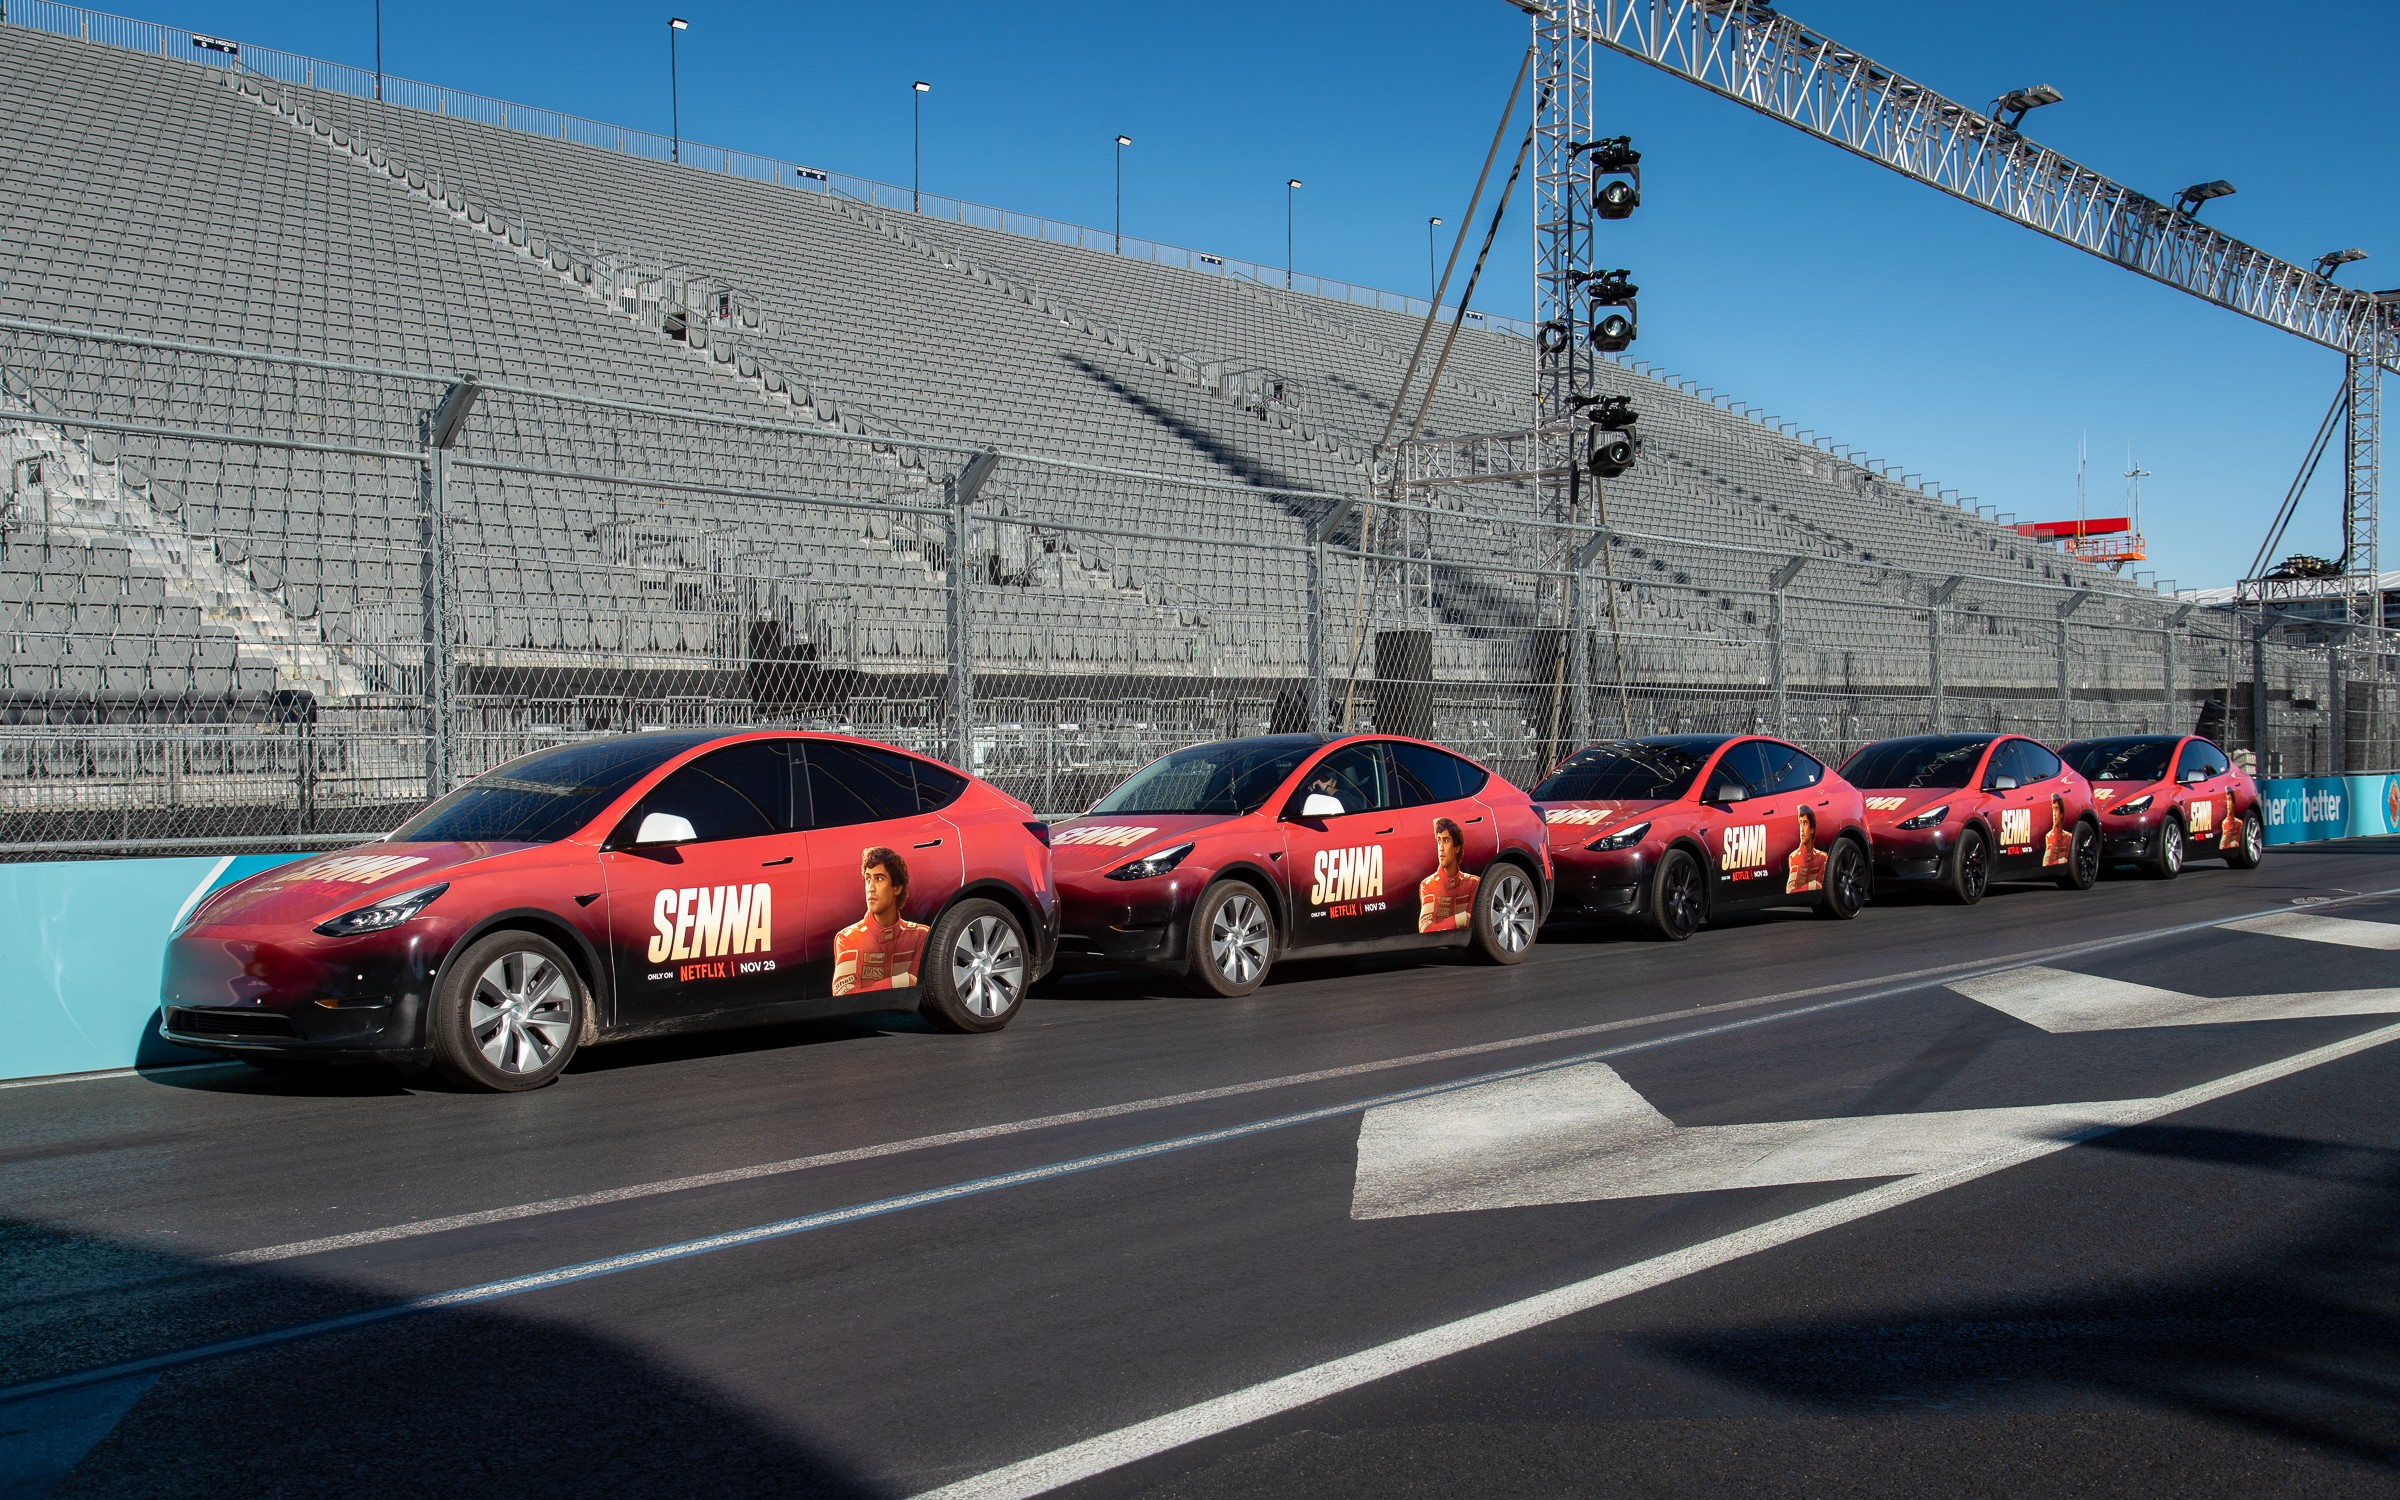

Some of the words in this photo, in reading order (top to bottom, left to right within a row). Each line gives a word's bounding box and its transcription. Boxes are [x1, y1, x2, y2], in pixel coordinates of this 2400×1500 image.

[2000, 808, 2031, 846] SENNA
[1721, 824, 1767, 871] SENNA
[272, 855, 430, 884] SENNA
[1023, 843, 1046, 893] N
[1311, 844, 1383, 906] SENNA
[647, 882, 772, 964] SENNA
[1329, 903, 1357, 919] NETFLIX
[1364, 903, 1378, 912] NOV
[1378, 901, 1387, 910] 29
[647, 972, 664, 981] ONLY
[664, 971, 674, 979] ON
[680, 961, 727, 982] NETFLIX
[740, 961, 762, 974] NOV
[763, 960, 776, 971] 29
[863, 966, 884, 976] BOSS
